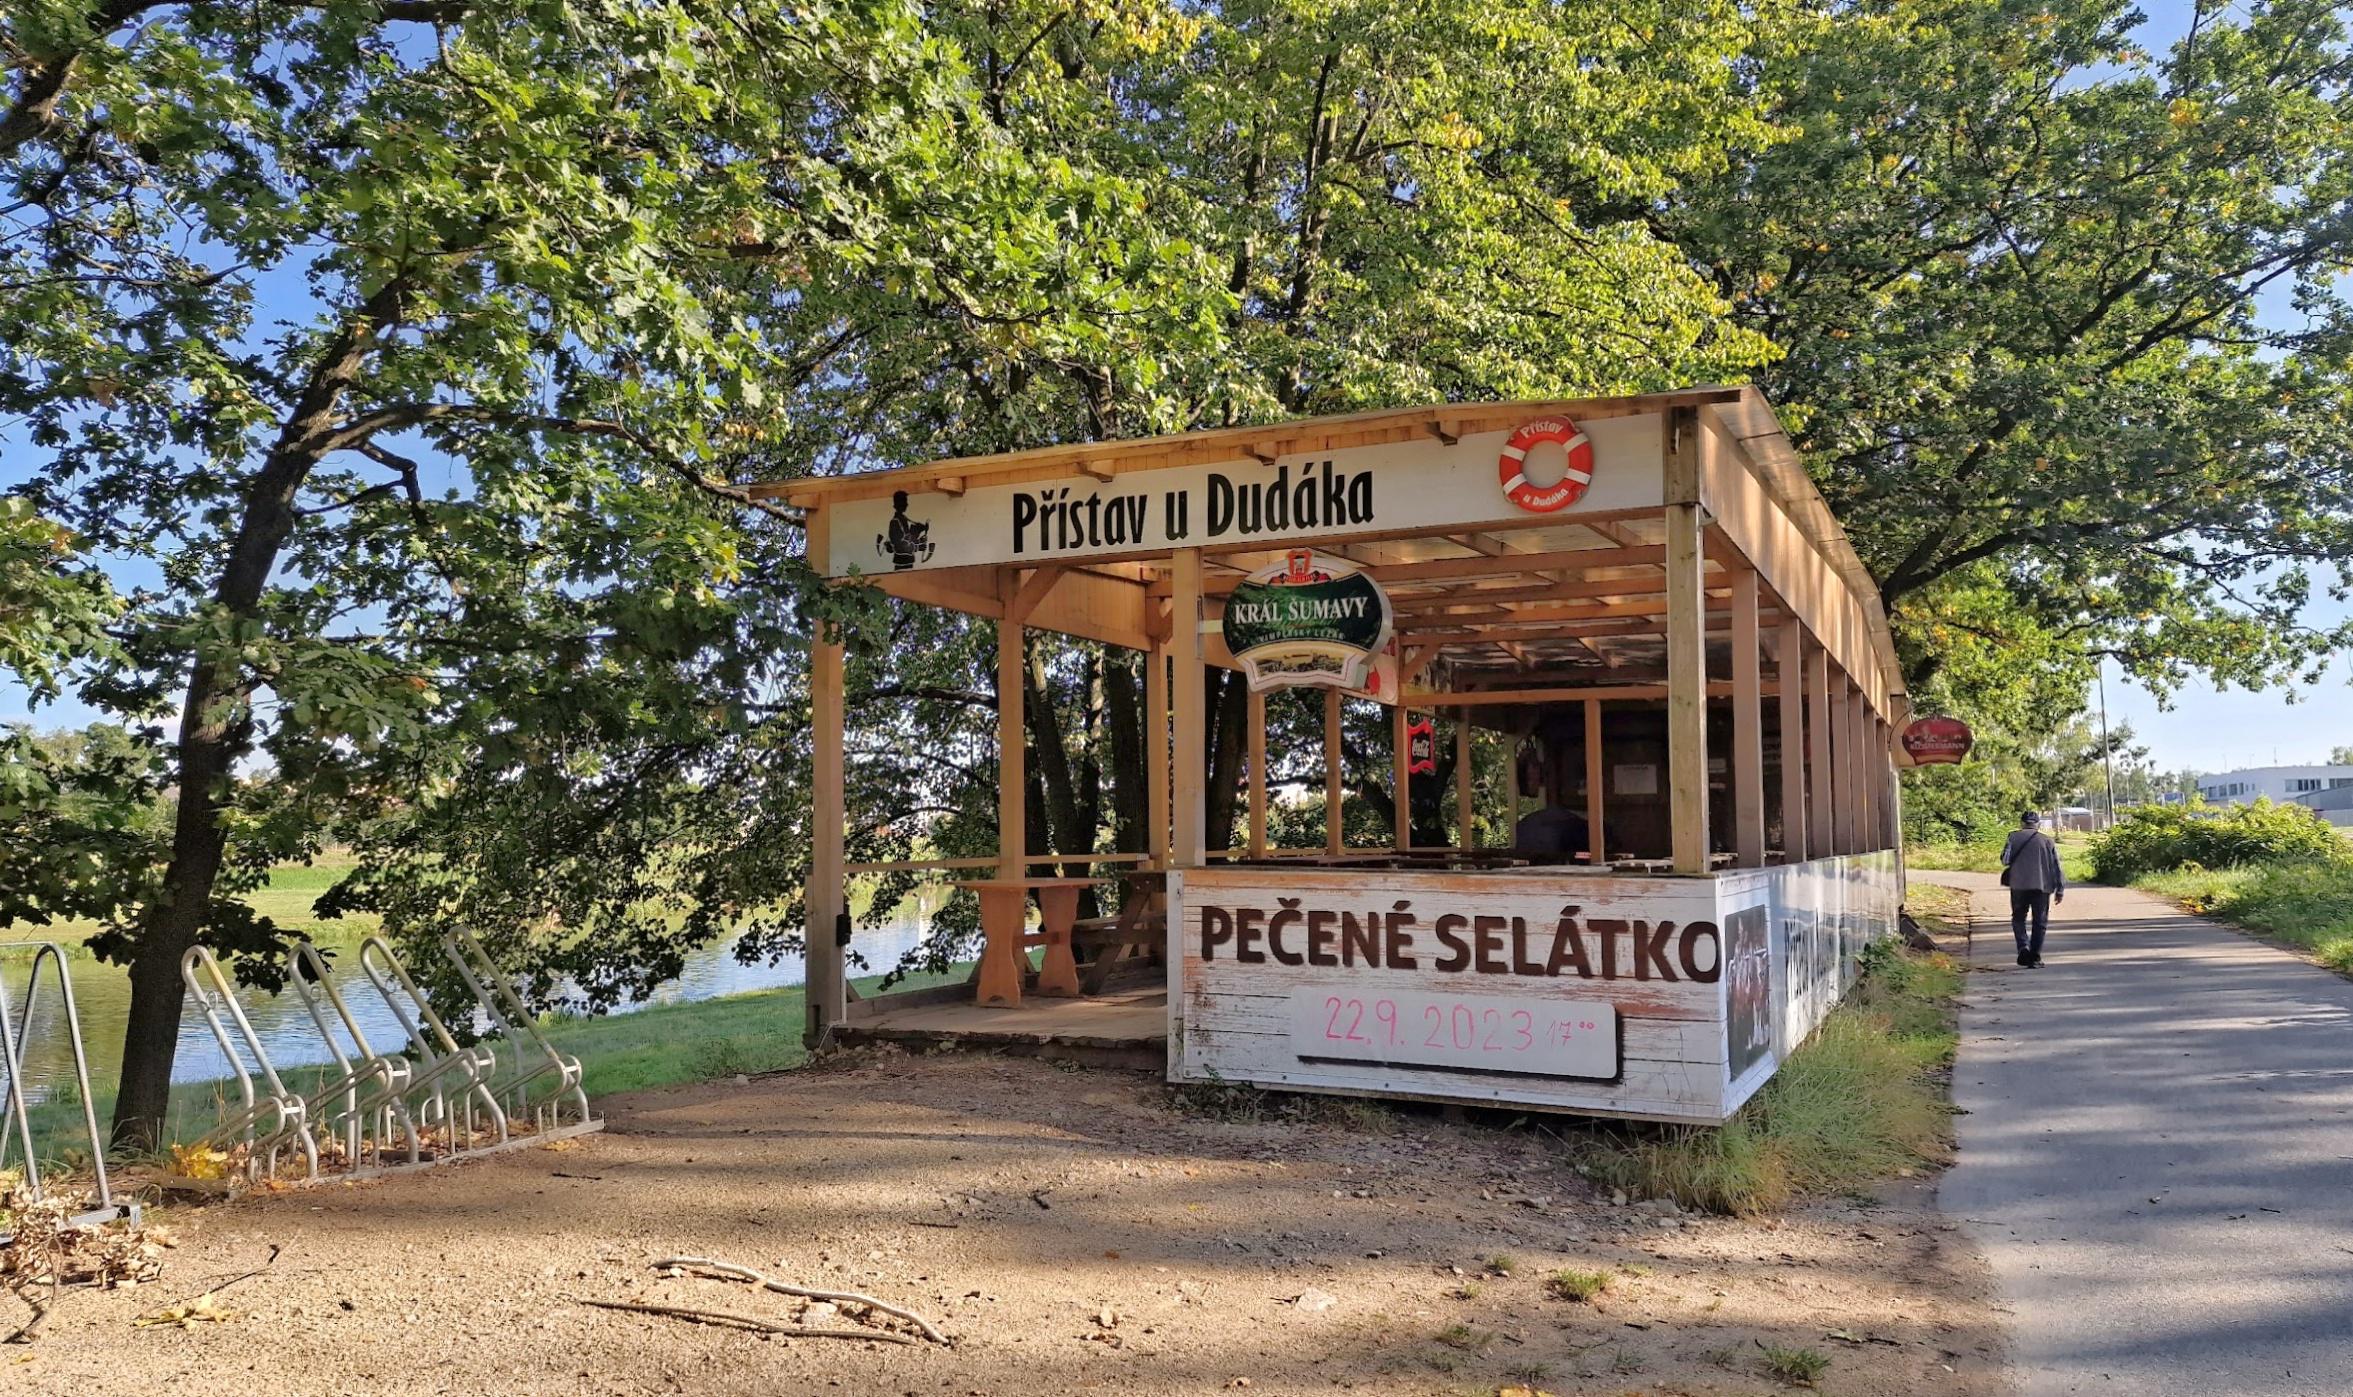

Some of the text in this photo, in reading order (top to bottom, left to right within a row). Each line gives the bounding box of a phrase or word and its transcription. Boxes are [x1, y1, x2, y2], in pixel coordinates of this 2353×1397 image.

[1013, 461, 1375, 553] Přístav u Dudáka
[1234, 596, 1368, 625] KRÁL ŠUMAVY
[1201, 898, 1722, 983] PEČENÉ SELÁTKO
[1423, 1004, 1533, 1052] 2023
